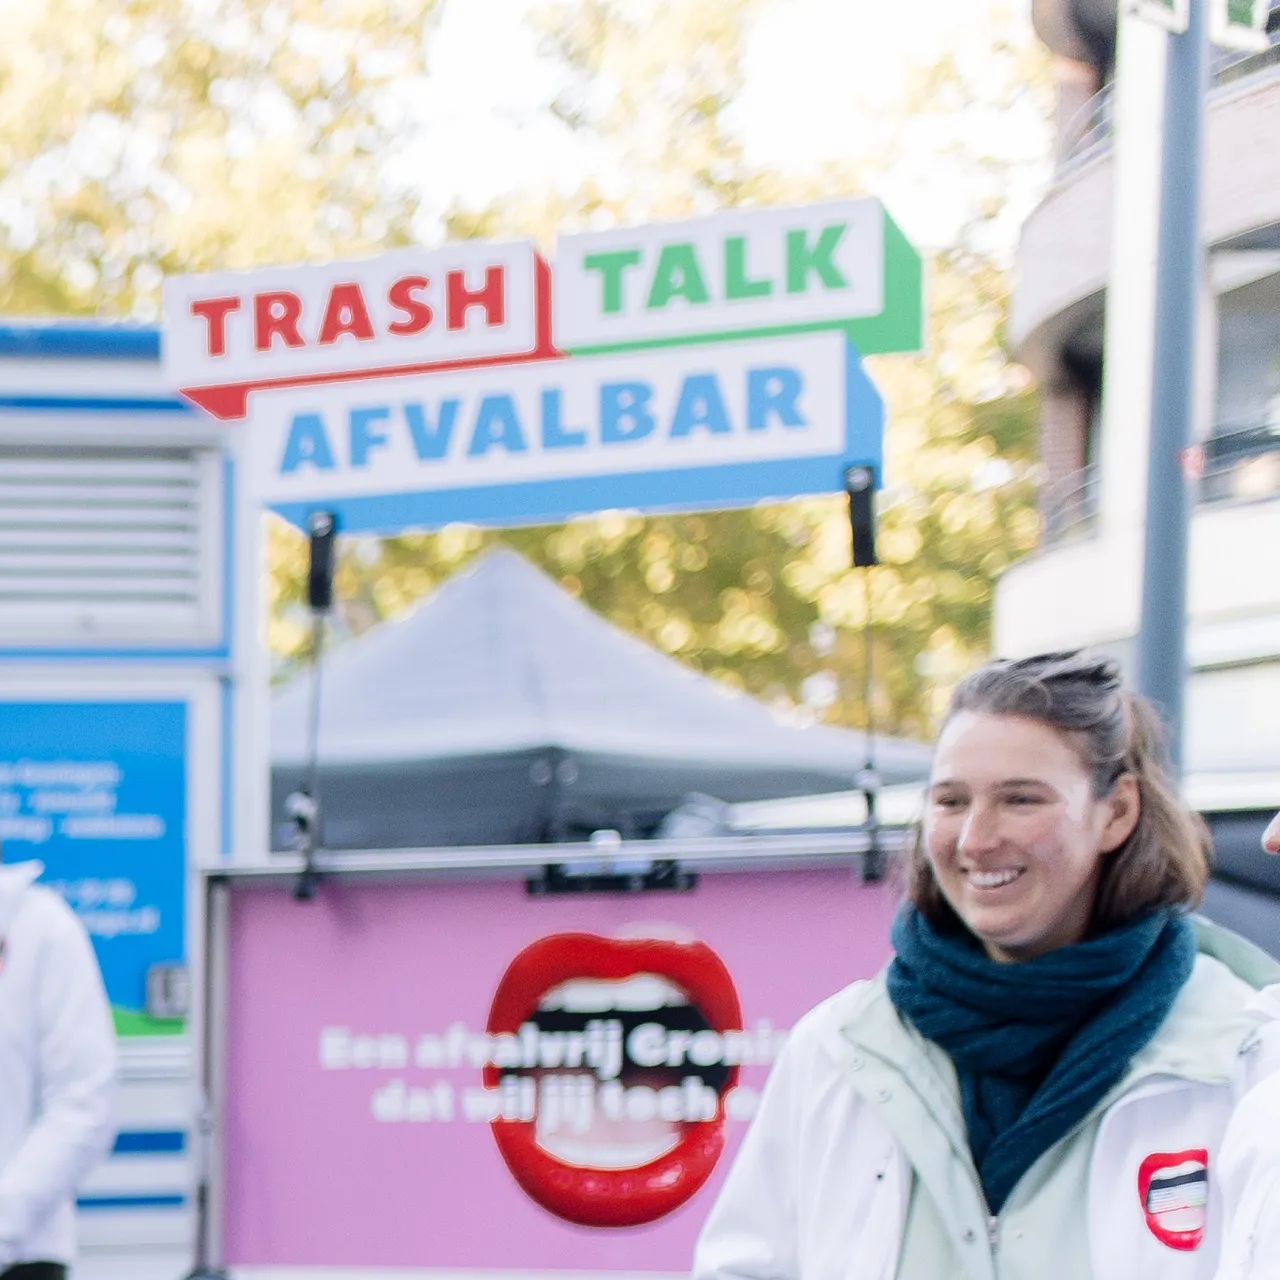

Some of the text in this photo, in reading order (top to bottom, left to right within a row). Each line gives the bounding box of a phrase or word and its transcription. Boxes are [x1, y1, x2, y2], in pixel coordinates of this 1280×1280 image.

[189, 223, 852, 358] TRASH TALK
[278, 365, 808, 476] AFVALBAR
[320, 1026, 407, 1070] Een
[415, 1022, 624, 1079] afvalvrij
[371, 1078, 454, 1123] dat
